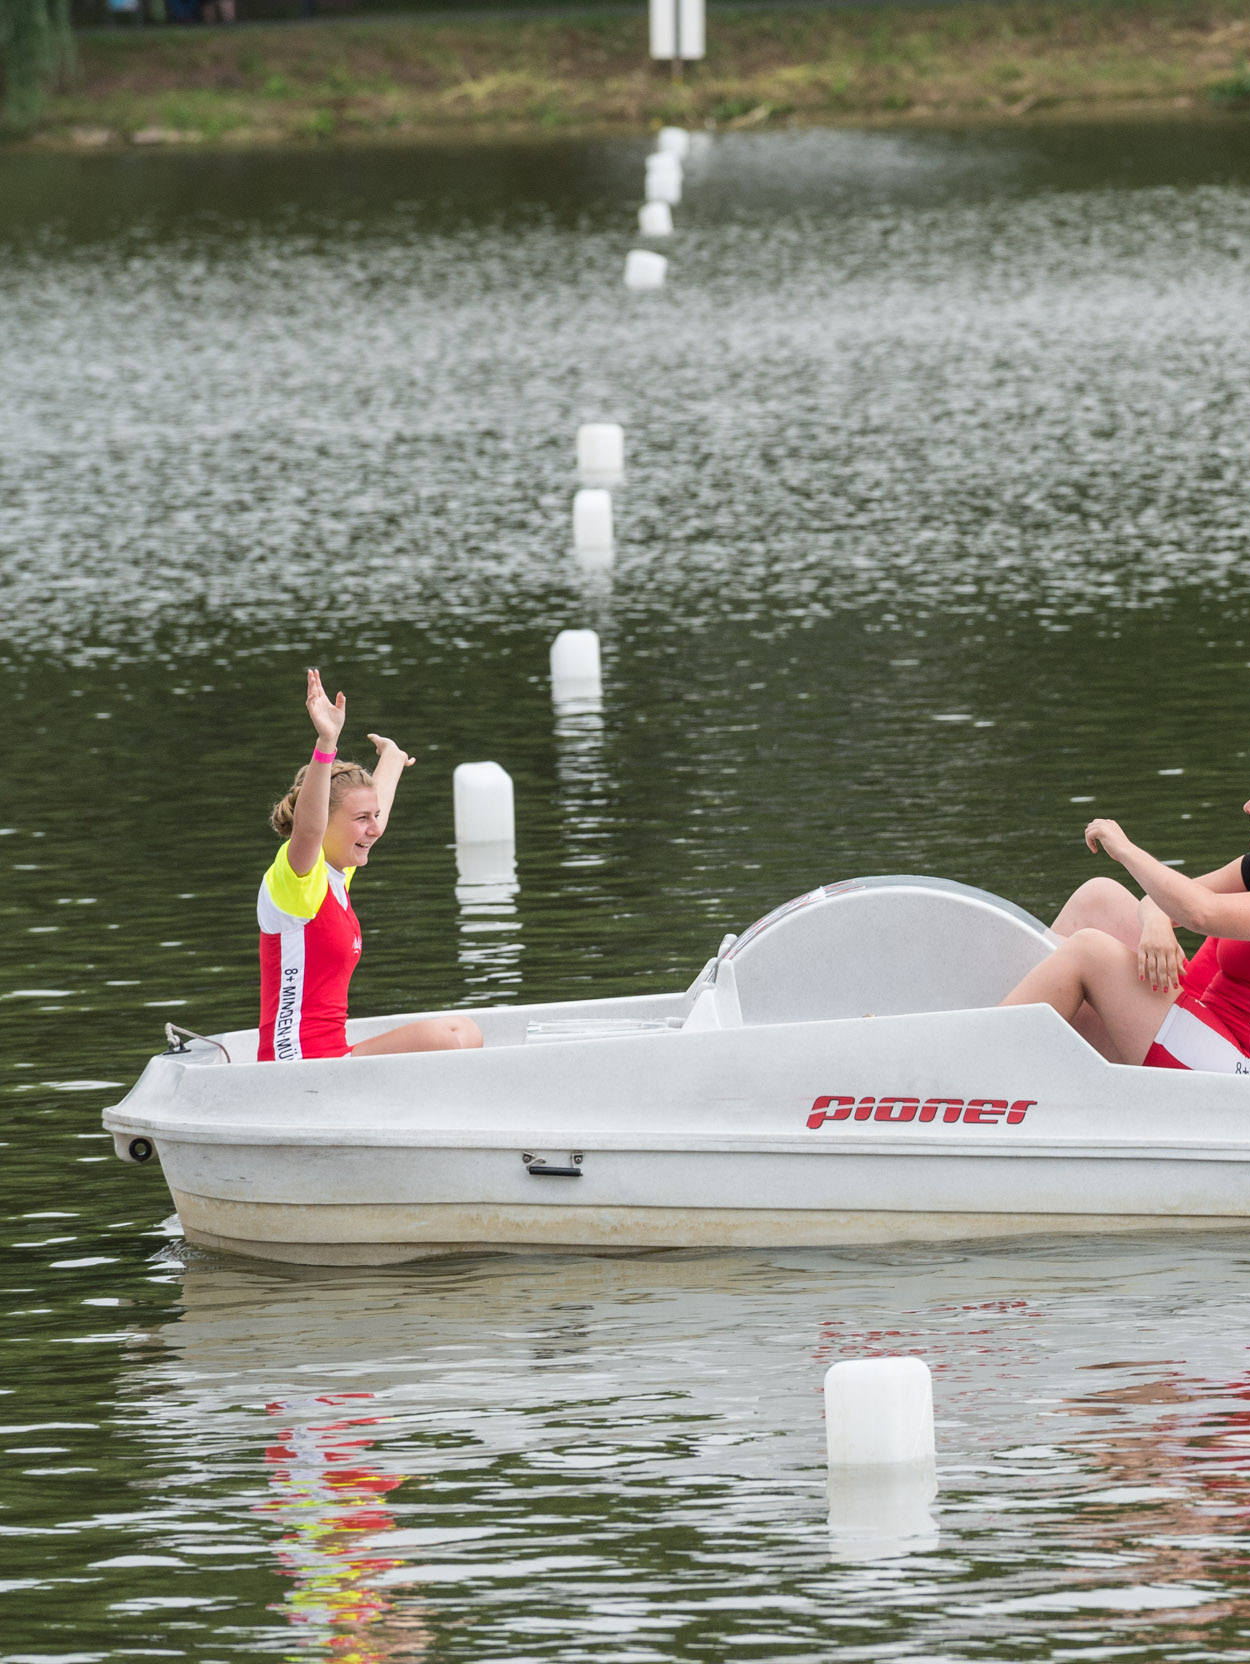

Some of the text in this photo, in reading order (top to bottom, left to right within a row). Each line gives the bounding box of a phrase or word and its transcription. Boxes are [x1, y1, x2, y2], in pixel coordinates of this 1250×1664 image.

[276, 968, 298, 1060] 8+ MINDEN-MÜ
[806, 1095, 1038, 1129] pioner
